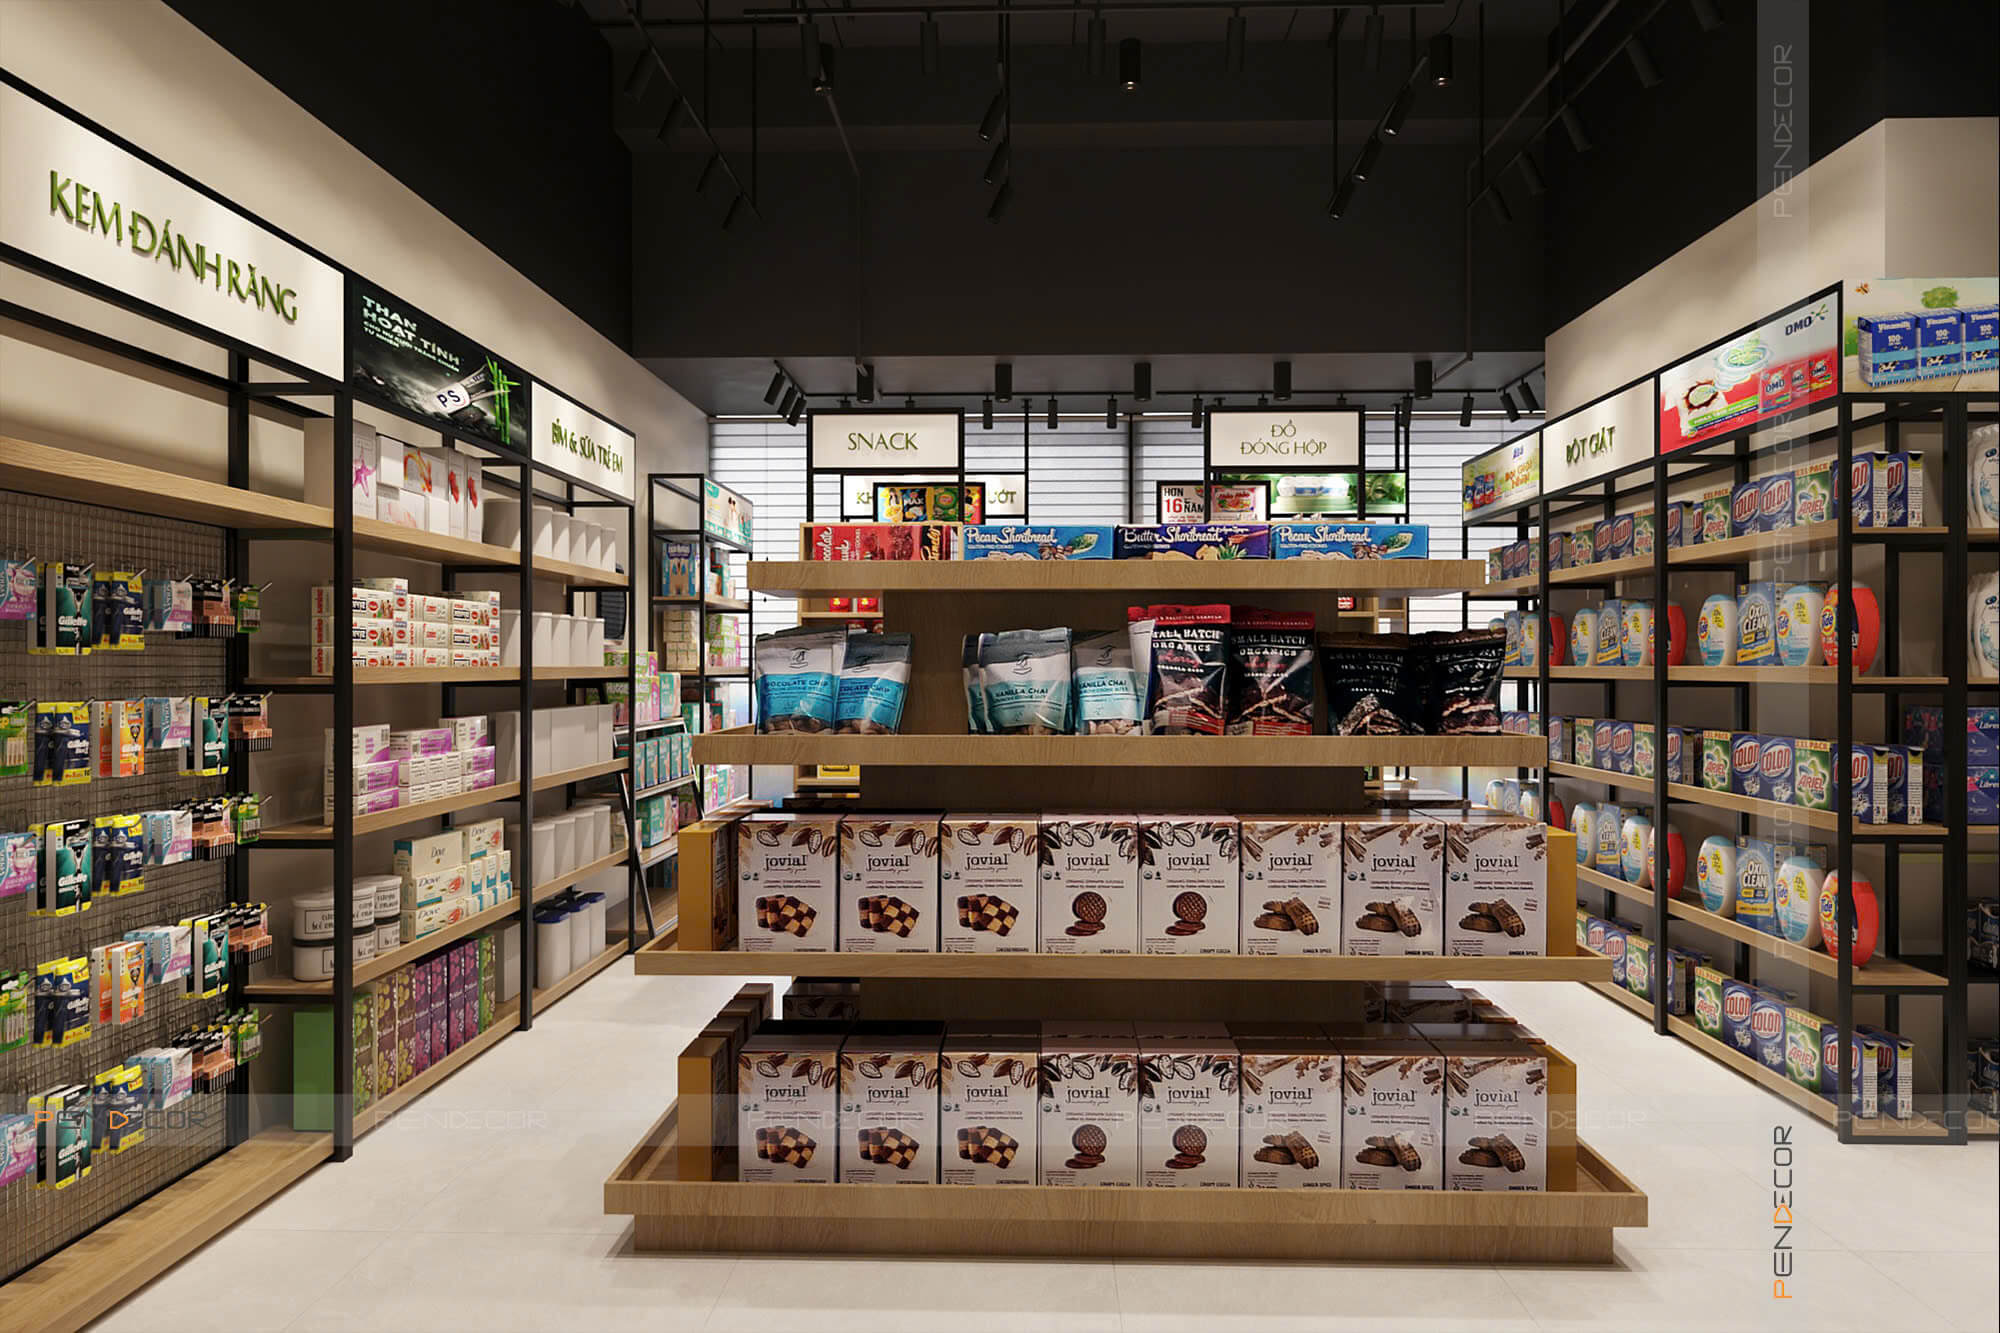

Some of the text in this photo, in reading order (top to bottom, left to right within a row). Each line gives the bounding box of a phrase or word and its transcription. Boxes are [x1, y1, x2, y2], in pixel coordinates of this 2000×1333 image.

[49, 169, 298, 323] KEM ĐÁNH RĂNG
[363, 295, 417, 332] THAN
[420, 337, 460, 365] TÍNH
[847, 432, 919, 451] SNACK
[1240, 440, 1290, 456] ĐÓNG
[1165, 498, 1183, 513] 16
[1153, 642, 1211, 652] ORGANICS
[1239, 647, 1297, 656] ORGANICS
[1799, 774, 1825, 790] ARIEL
[763, 854, 808, 872] jovial
[866, 854, 909, 872] jovial
[965, 852, 1009, 871] jovial
[1065, 853, 1111, 872] jovial
[1166, 853, 1211, 872] jovial
[1267, 852, 1313, 872] jovial
[1371, 853, 1416, 872] jovial
[1474, 853, 1519, 872] jovial
[418, 875, 441, 888] Dove
[418, 906, 440, 920] Dove
[1724, 995, 1751, 1017] COLON
[1752, 1011, 1781, 1033] COLON
[1788, 1046, 1814, 1066] ARIEL
[763, 1085, 808, 1102] jovial
[866, 1085, 910, 1102] jovial
[965, 1084, 1009, 1102] jovial
[1065, 1086, 1111, 1103] jovial
[1166, 1086, 1211, 1103] jovial
[1267, 1086, 1313, 1104] jovial
[1371, 1087, 1416, 1104] jovial
[1473, 1088, 1519, 1105] jovial
